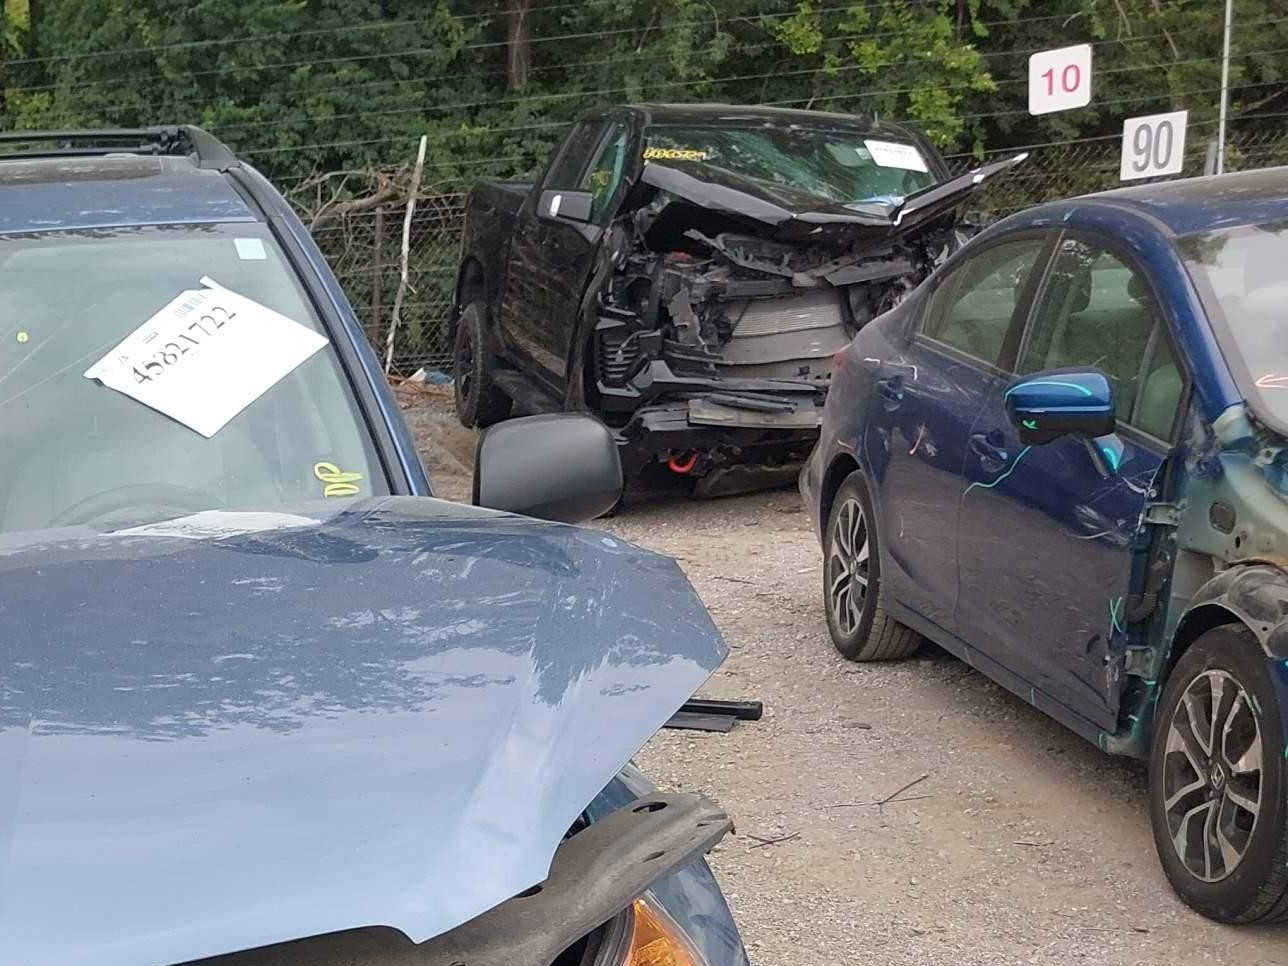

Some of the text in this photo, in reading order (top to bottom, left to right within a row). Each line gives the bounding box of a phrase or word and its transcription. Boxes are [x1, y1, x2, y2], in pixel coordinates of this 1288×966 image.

[1041, 64, 1081, 96] 10
[1132, 120, 1174, 173] 90
[131, 305, 237, 385] 45821722
